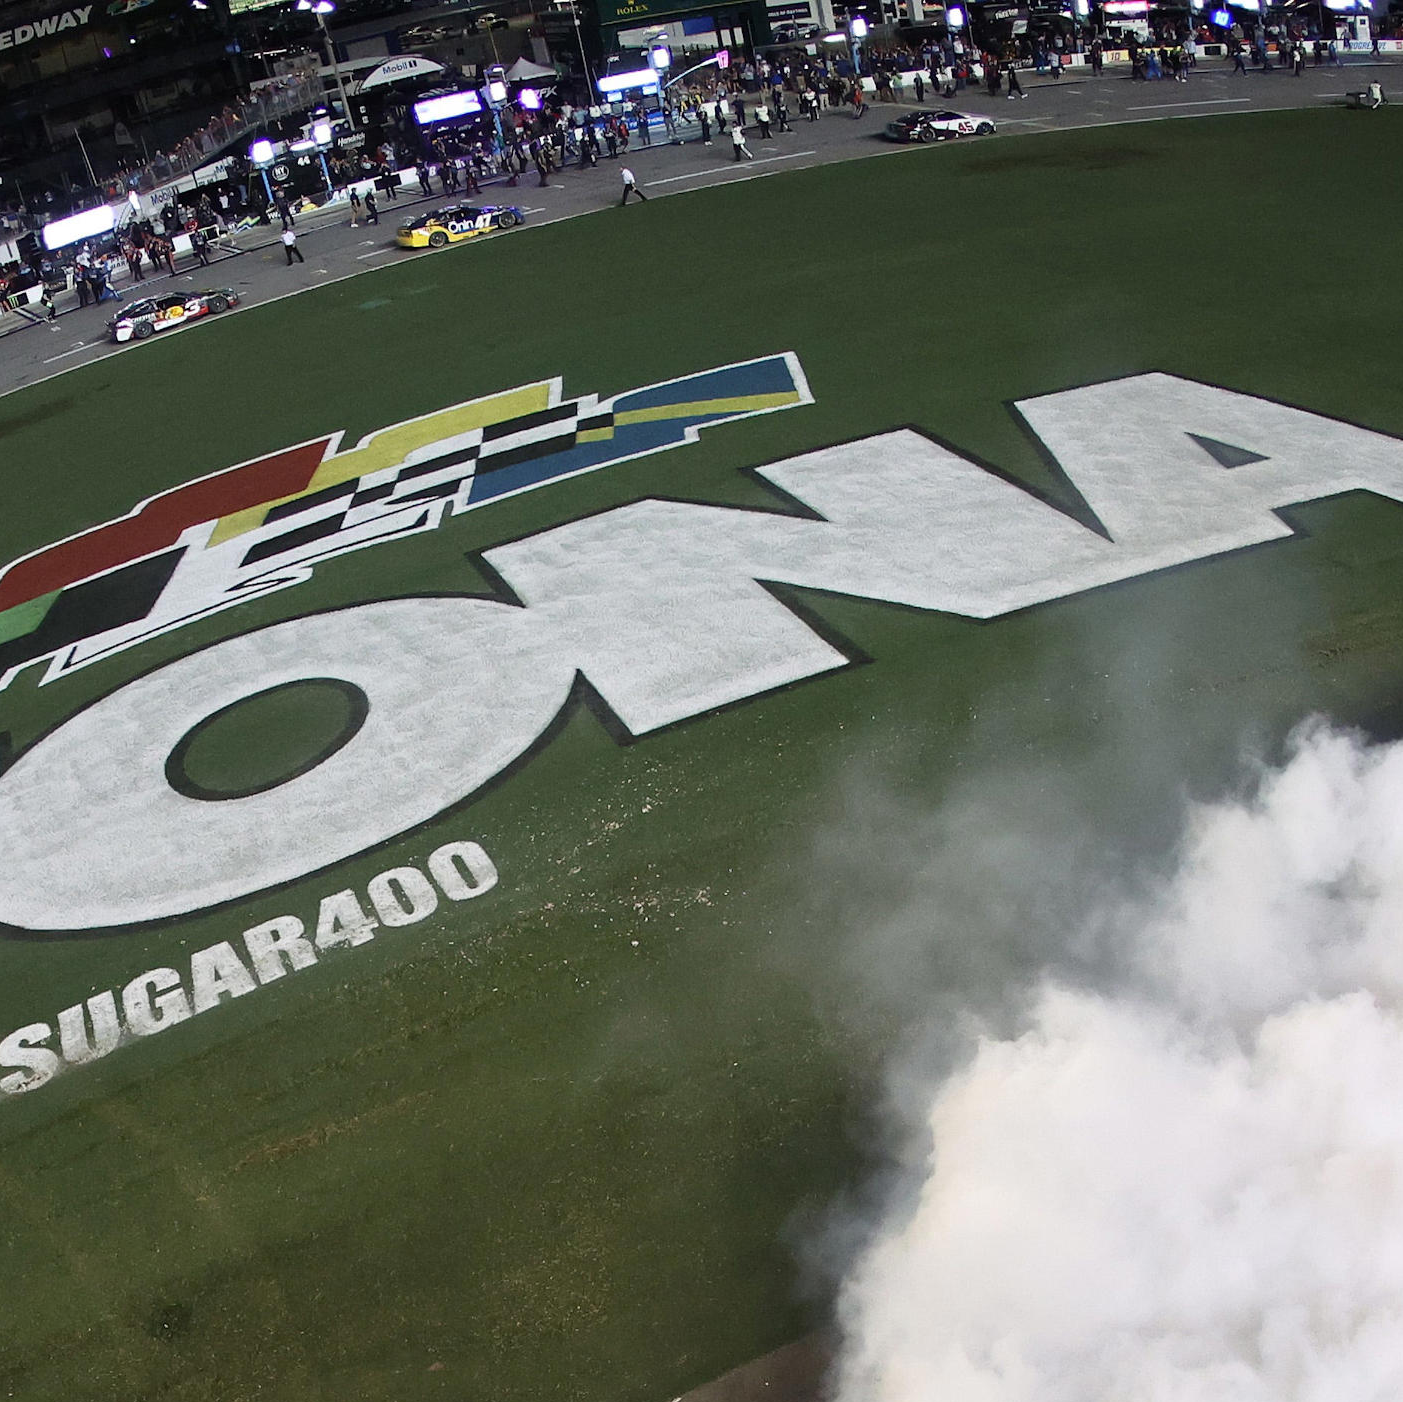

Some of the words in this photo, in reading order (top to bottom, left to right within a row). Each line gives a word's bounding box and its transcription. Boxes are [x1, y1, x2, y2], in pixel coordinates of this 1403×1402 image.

[616, 4, 649, 16] ROLEX
[382, 63, 408, 75] Mobil
[184, 299, 201, 316] 3
